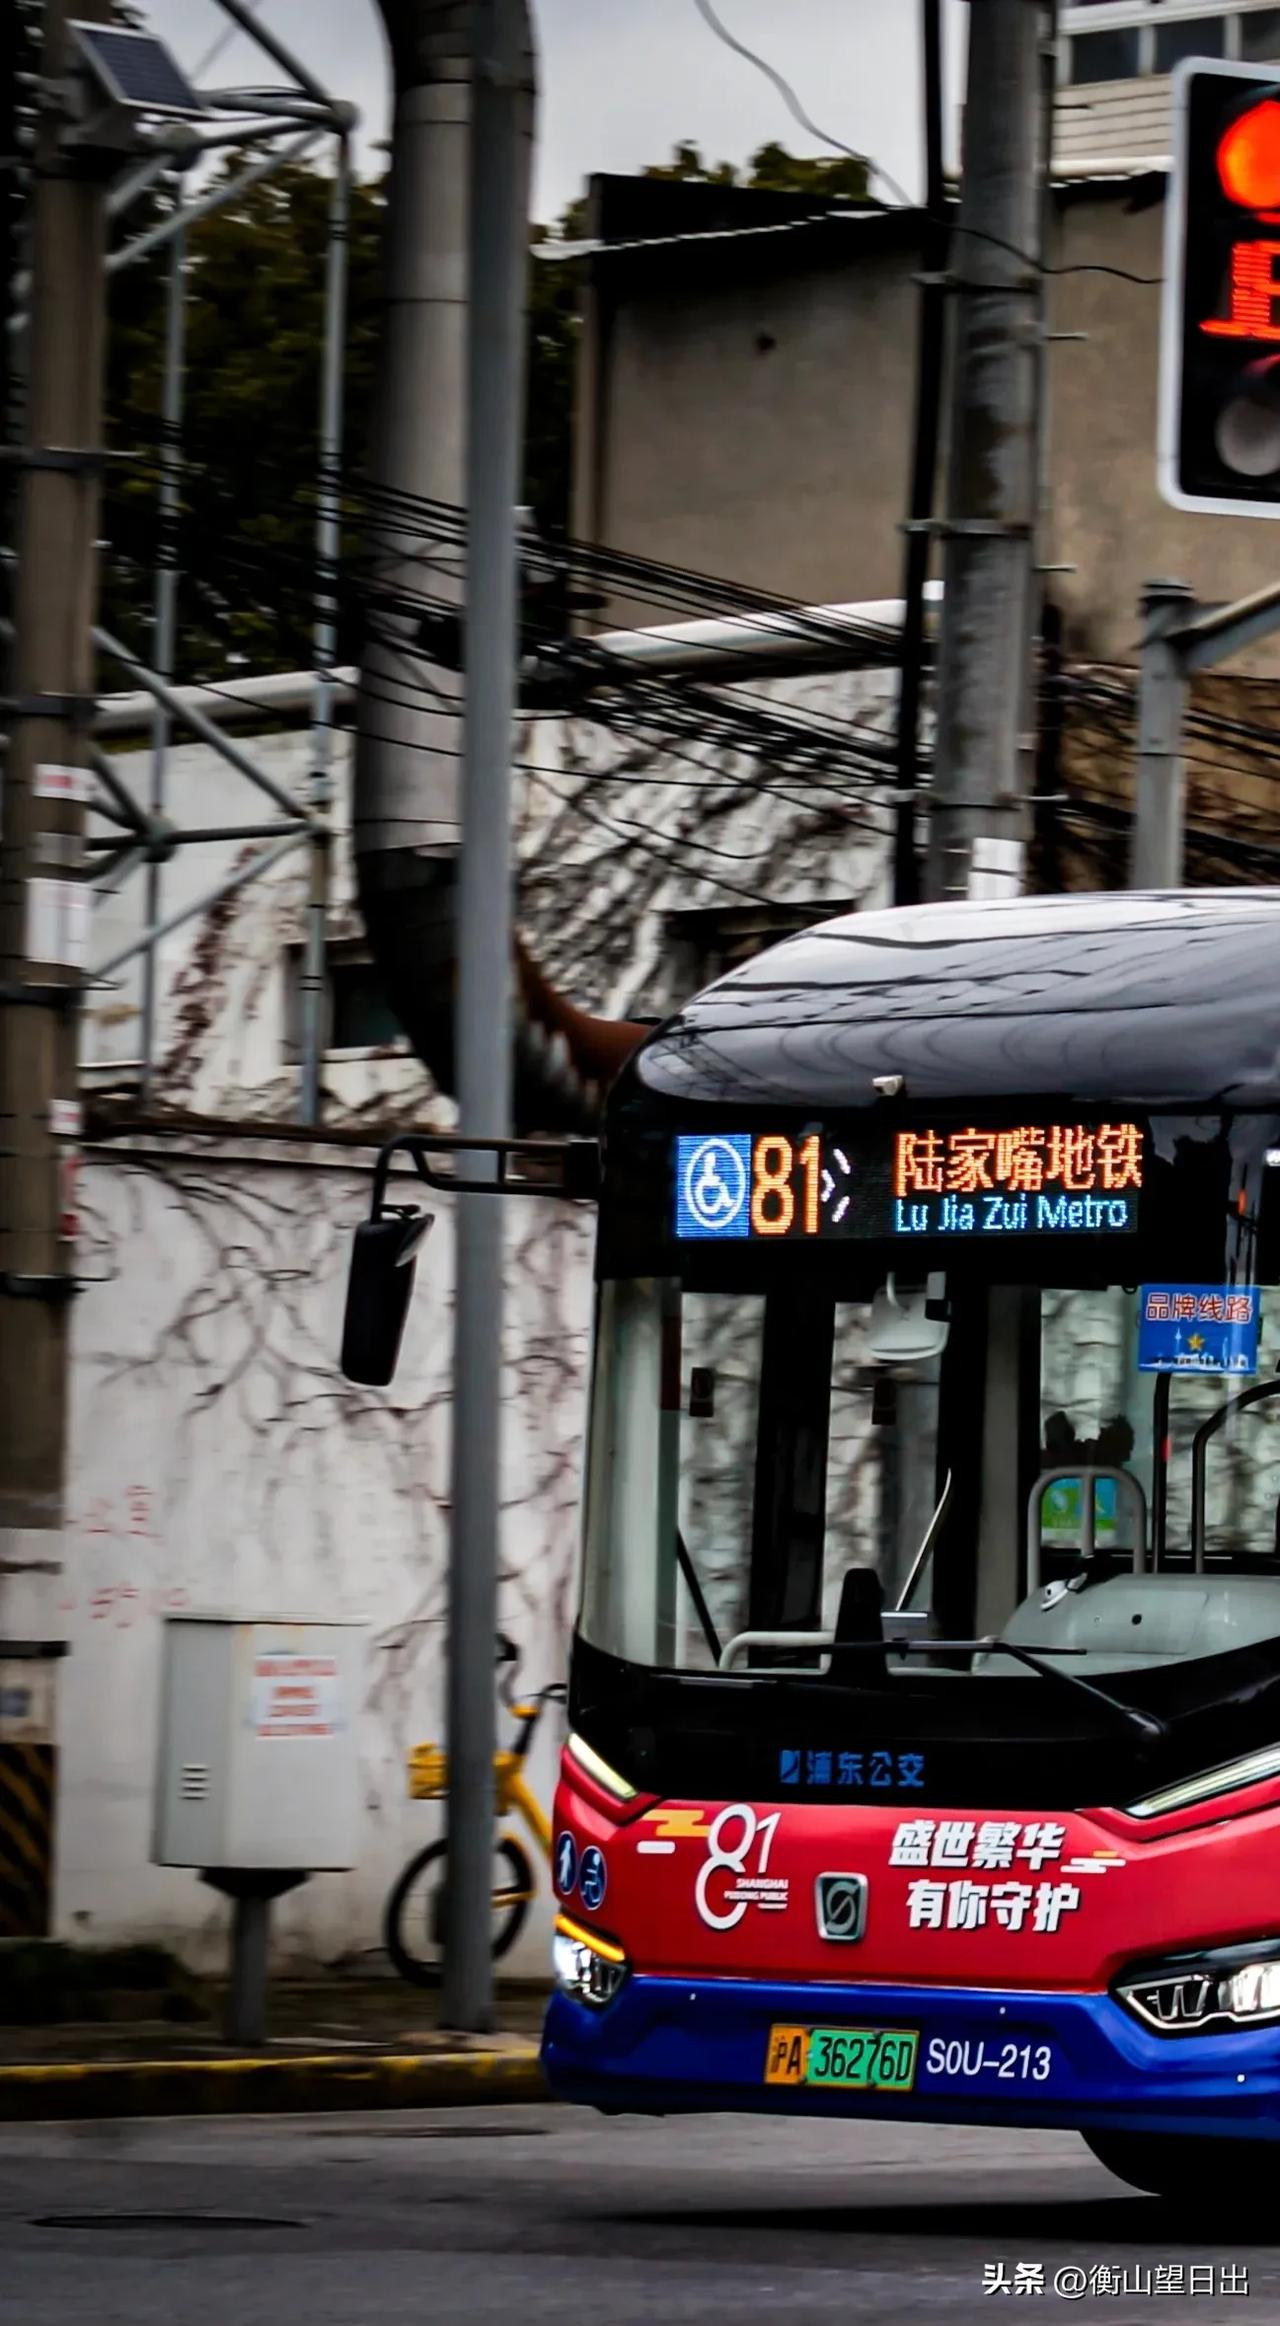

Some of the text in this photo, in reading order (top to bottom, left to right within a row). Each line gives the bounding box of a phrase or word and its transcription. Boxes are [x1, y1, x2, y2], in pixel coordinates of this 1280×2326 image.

[896, 1123, 1144, 1197] 陆家嘴地铁
[752, 1135, 820, 1234] 81
[896, 1193, 1128, 1232] Lu Jia Zui Metro
[1146, 1292, 1253, 1324] 品牌线路
[807, 1751, 925, 1787] 浦东公交
[888, 1819, 1066, 1870] 盛世繁华
[736, 1878, 789, 1889] SHANGHAI
[906, 1879, 1080, 1932] 有你守护
